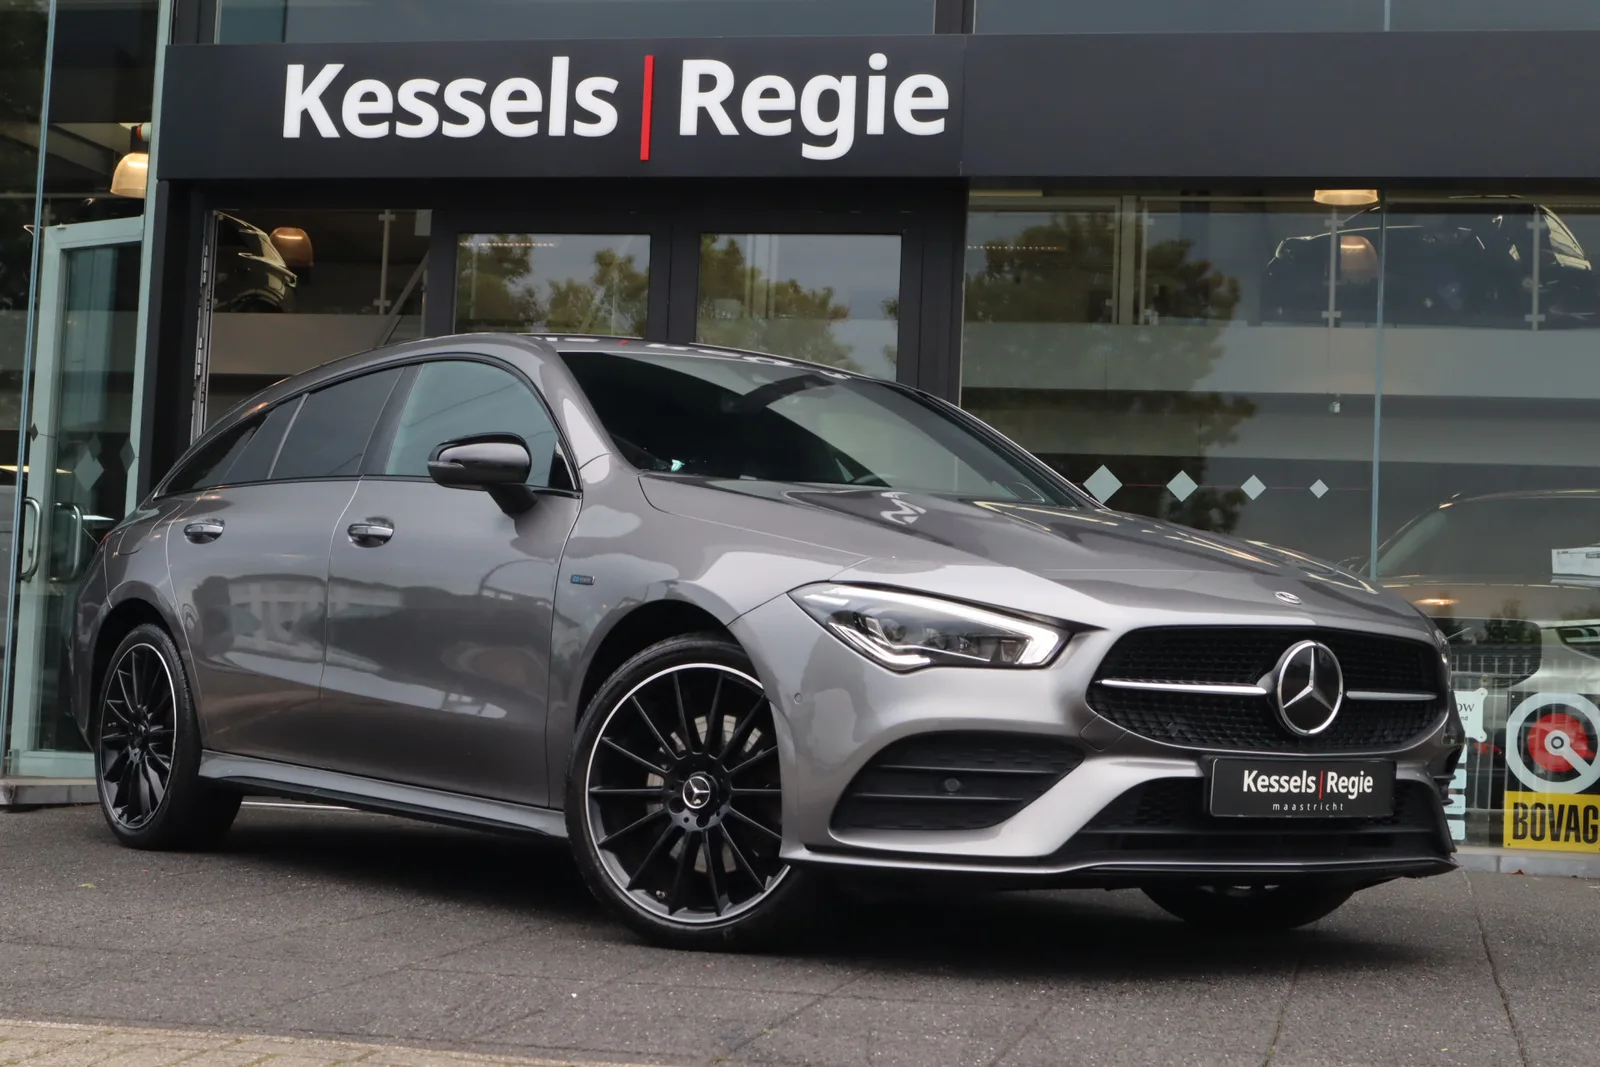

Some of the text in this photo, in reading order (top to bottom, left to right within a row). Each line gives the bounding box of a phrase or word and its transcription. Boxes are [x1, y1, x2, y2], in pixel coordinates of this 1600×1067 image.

[282, 52, 949, 161] Kessels Regie
[1242, 769, 1374, 800] Kessels Regie
[1272, 802, 1344, 811] maastricht
[1512, 802, 1599, 844] BOVAG
